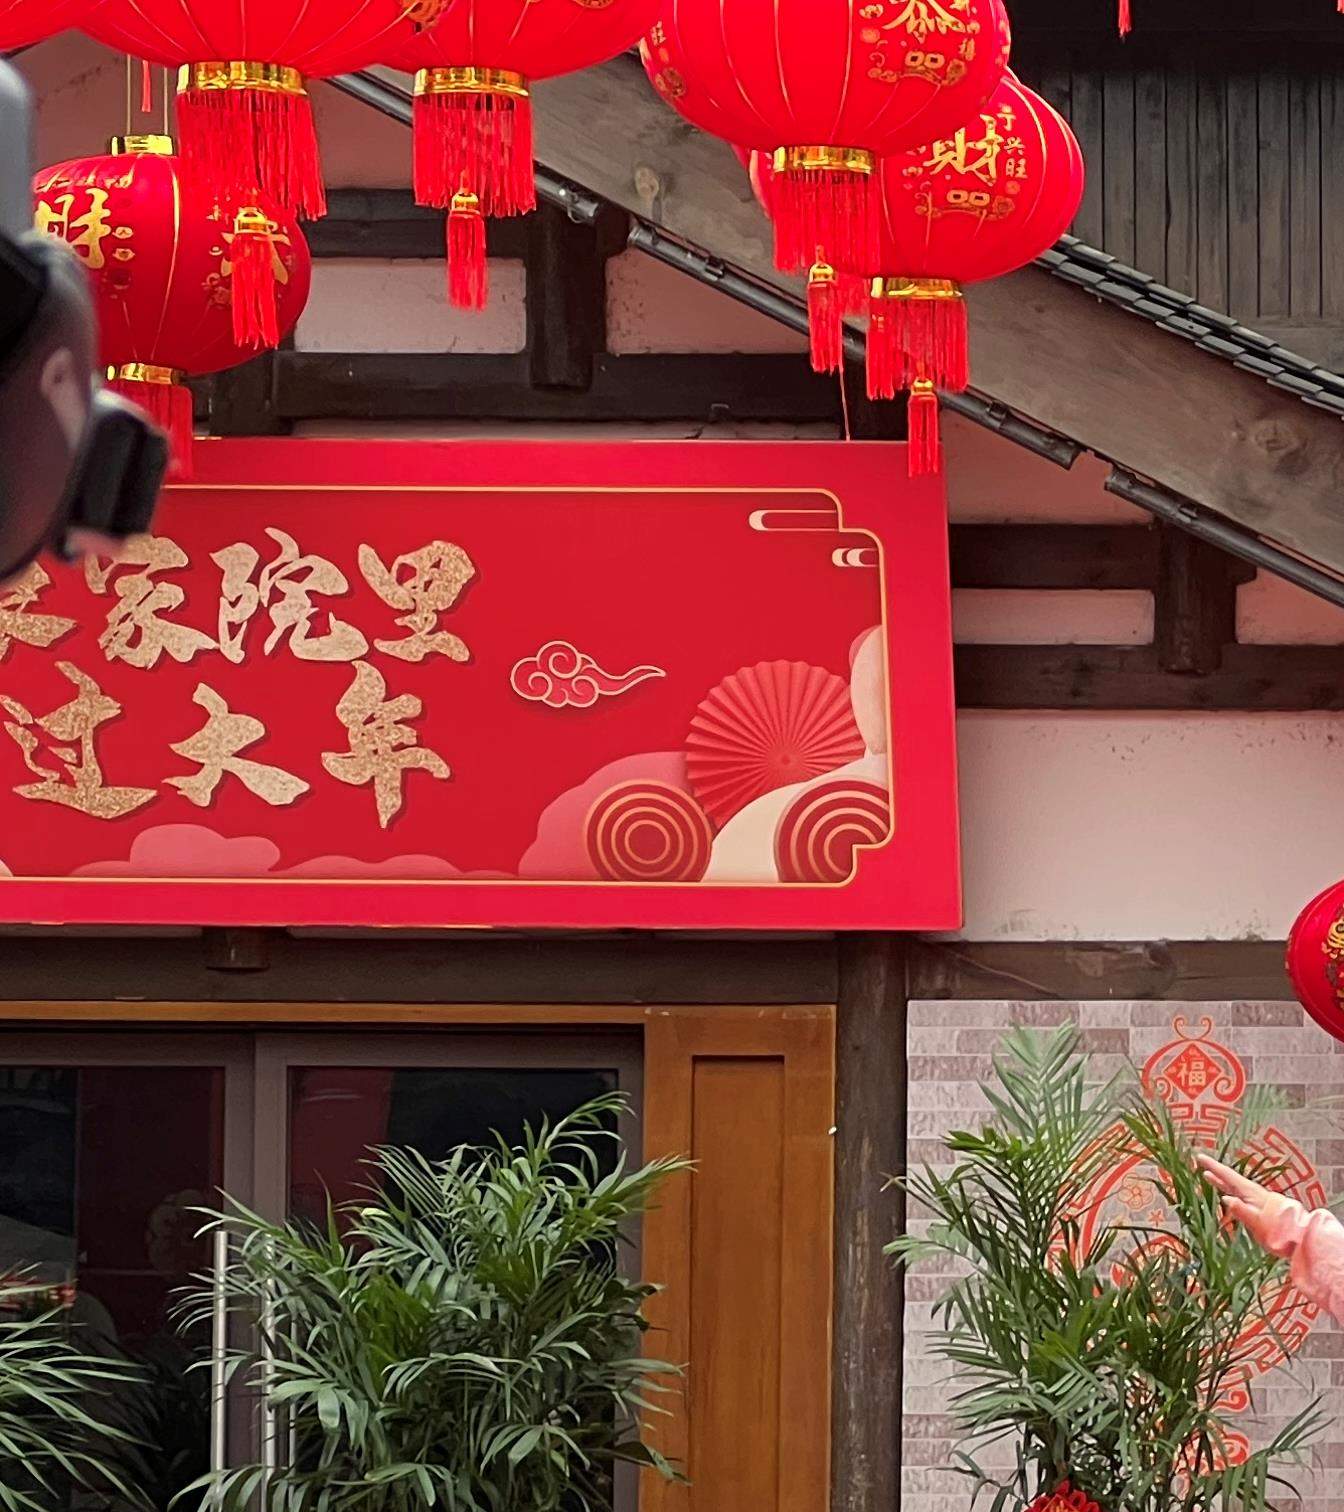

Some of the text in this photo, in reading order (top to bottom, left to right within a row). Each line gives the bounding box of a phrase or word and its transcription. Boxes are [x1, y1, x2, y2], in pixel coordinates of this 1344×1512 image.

[0, 660, 452, 830] 过大年
[1176, 1055, 1207, 1088] 福
